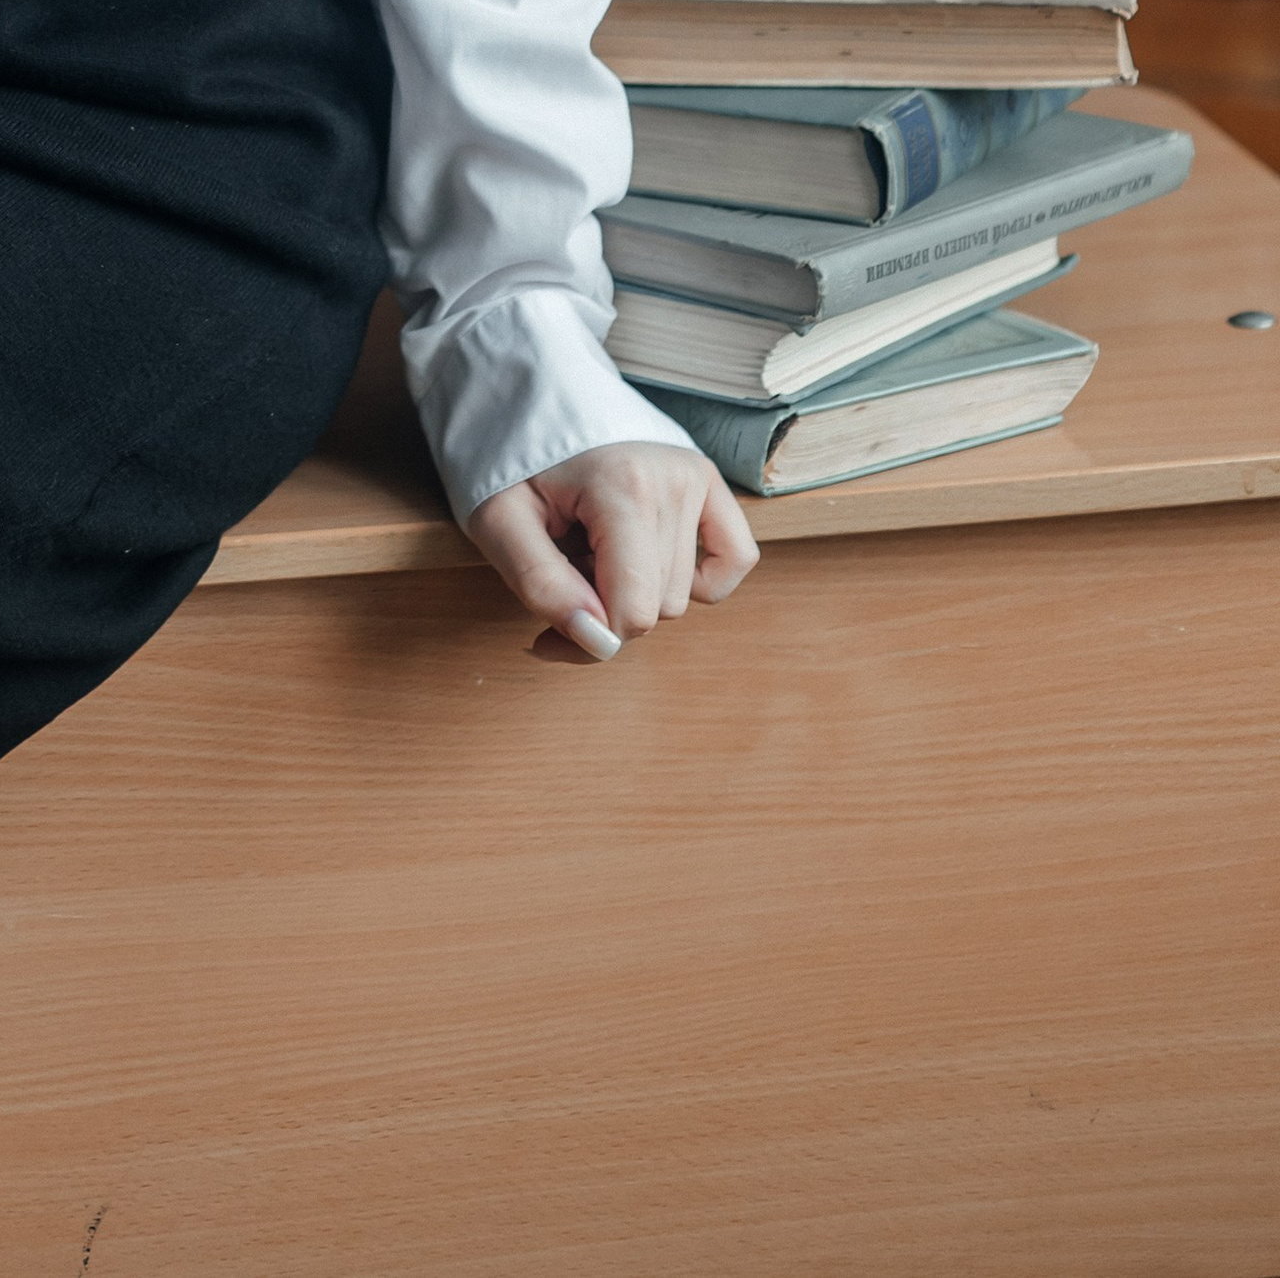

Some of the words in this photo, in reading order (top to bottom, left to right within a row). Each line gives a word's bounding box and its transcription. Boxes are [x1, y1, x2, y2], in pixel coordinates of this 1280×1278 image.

[933, 228, 989, 261] НАШЕГО
[991, 212, 1033, 246] ГЕРОЙ
[865, 247, 930, 284] ВРЕМЕНИ
